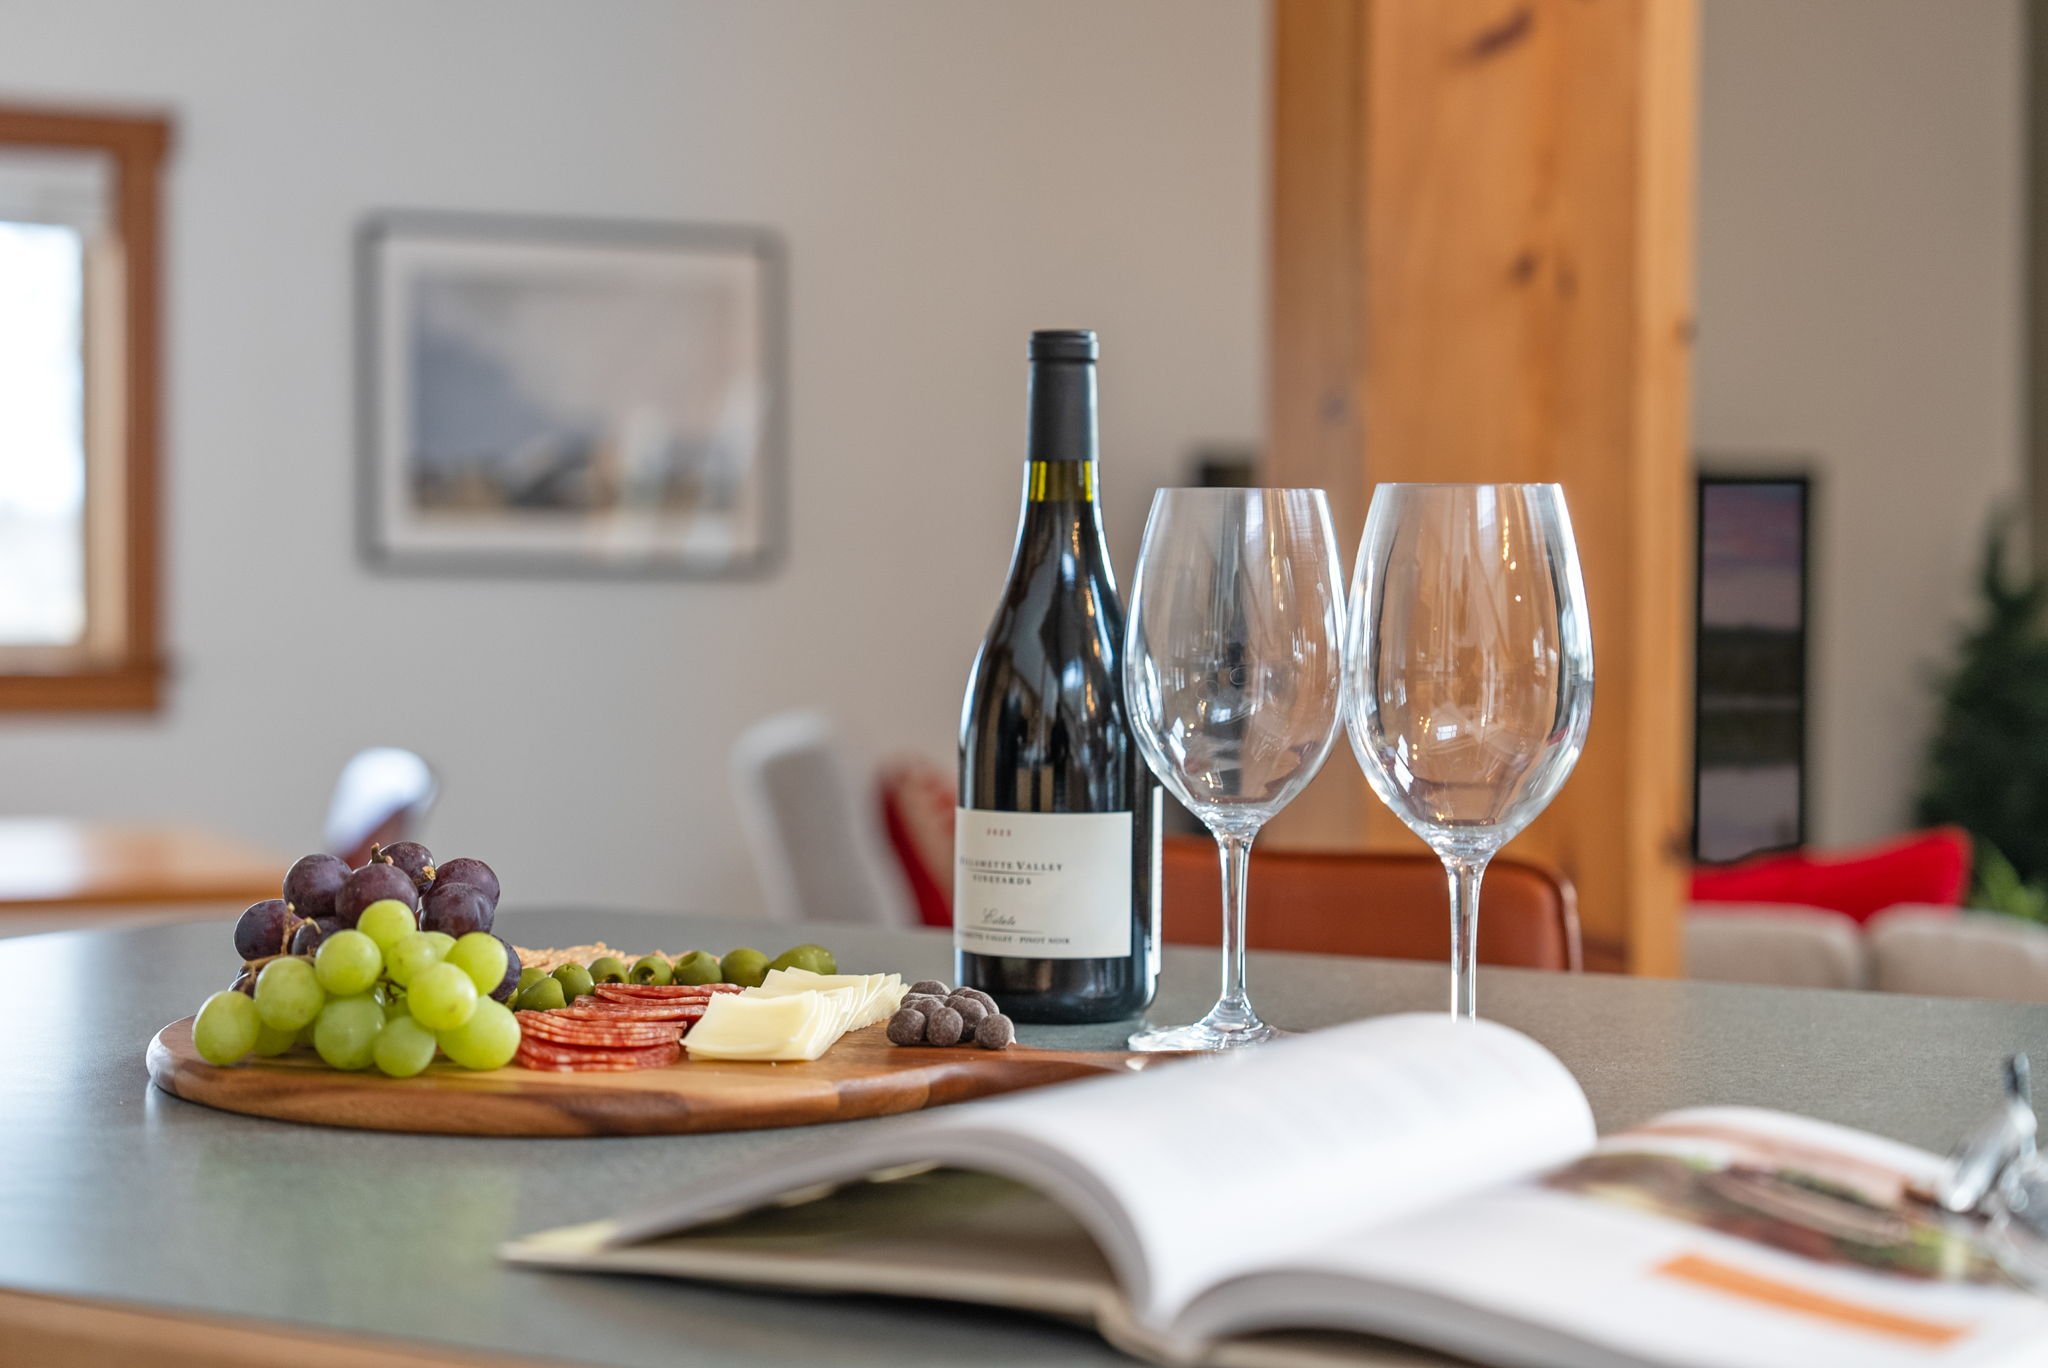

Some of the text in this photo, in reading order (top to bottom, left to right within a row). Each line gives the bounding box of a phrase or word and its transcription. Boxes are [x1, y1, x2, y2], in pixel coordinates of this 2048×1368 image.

[1016, 861, 1063, 872] VALLEY
[972, 874, 1032, 886] VINEYARDS
[981, 907, 1016, 926] Estate
